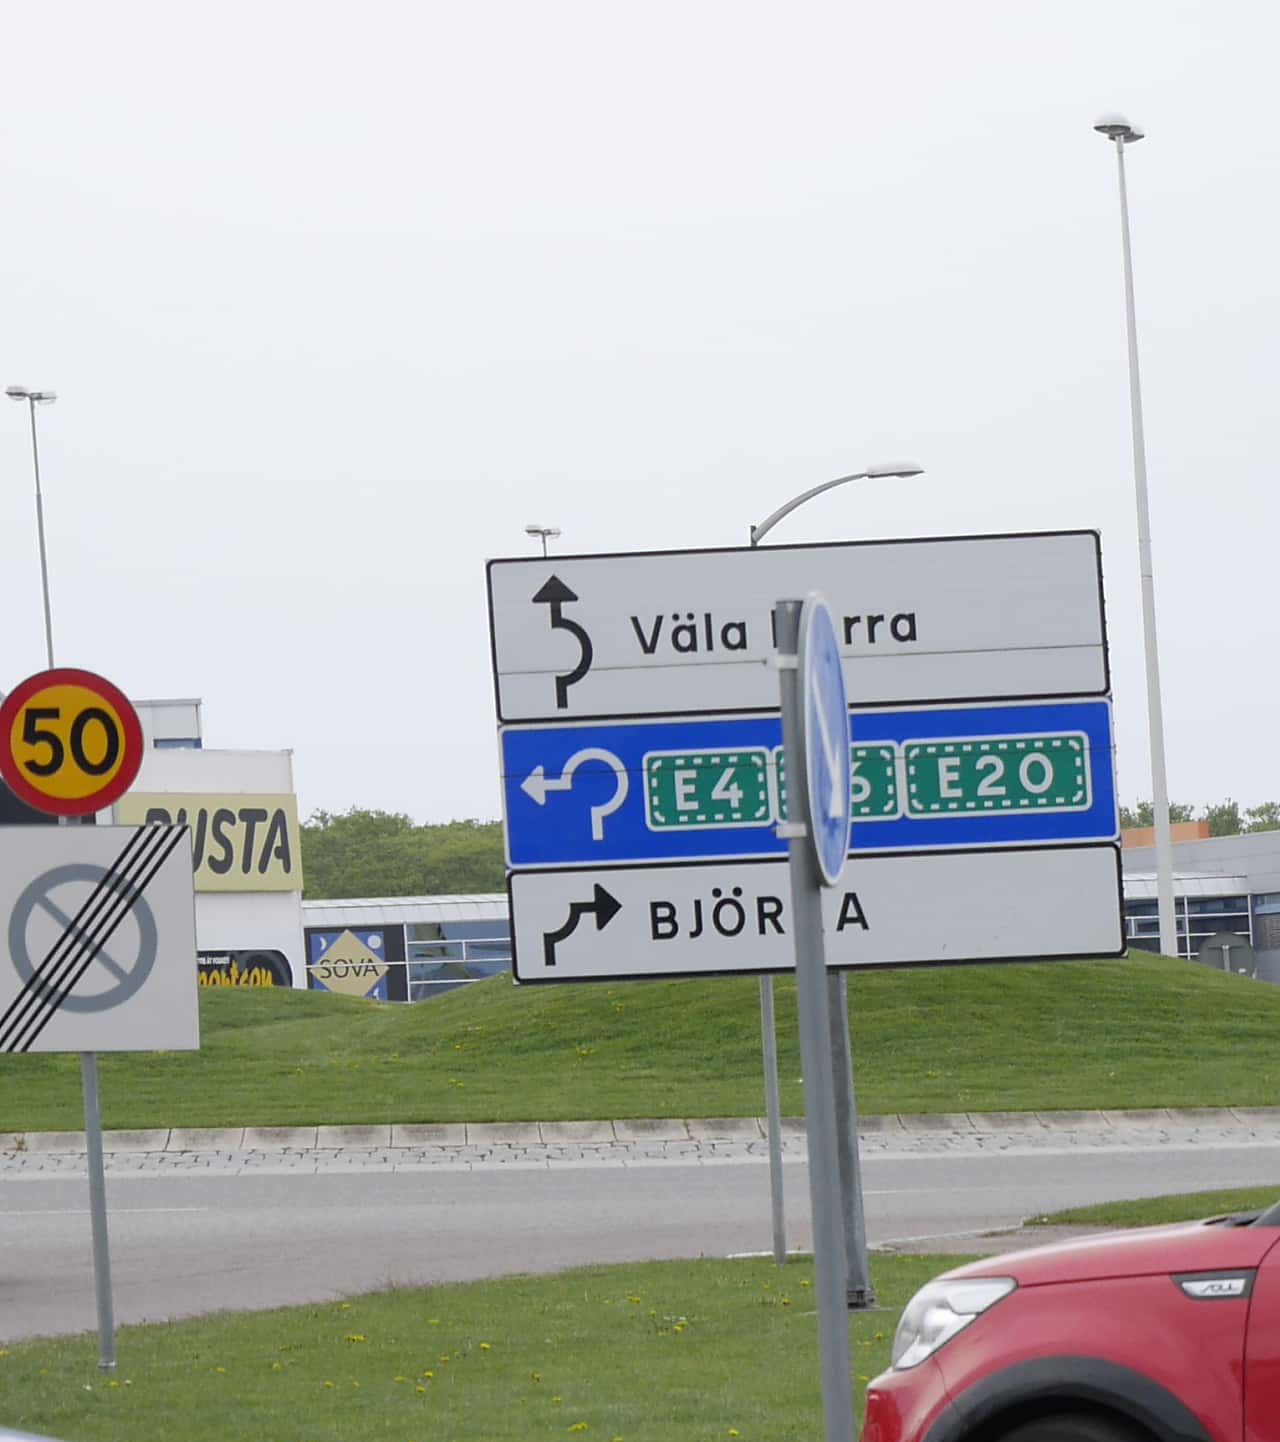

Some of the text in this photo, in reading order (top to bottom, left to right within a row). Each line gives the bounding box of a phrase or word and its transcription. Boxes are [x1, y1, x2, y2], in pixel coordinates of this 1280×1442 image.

[630, 611, 748, 655] Väla
[22, 706, 120, 776] 50
[674, 766, 743, 812] E4
[938, 752, 1053, 799] E20
[650, 886, 870, 941] BJÖRA
[318, 958, 380, 979] SOVA
